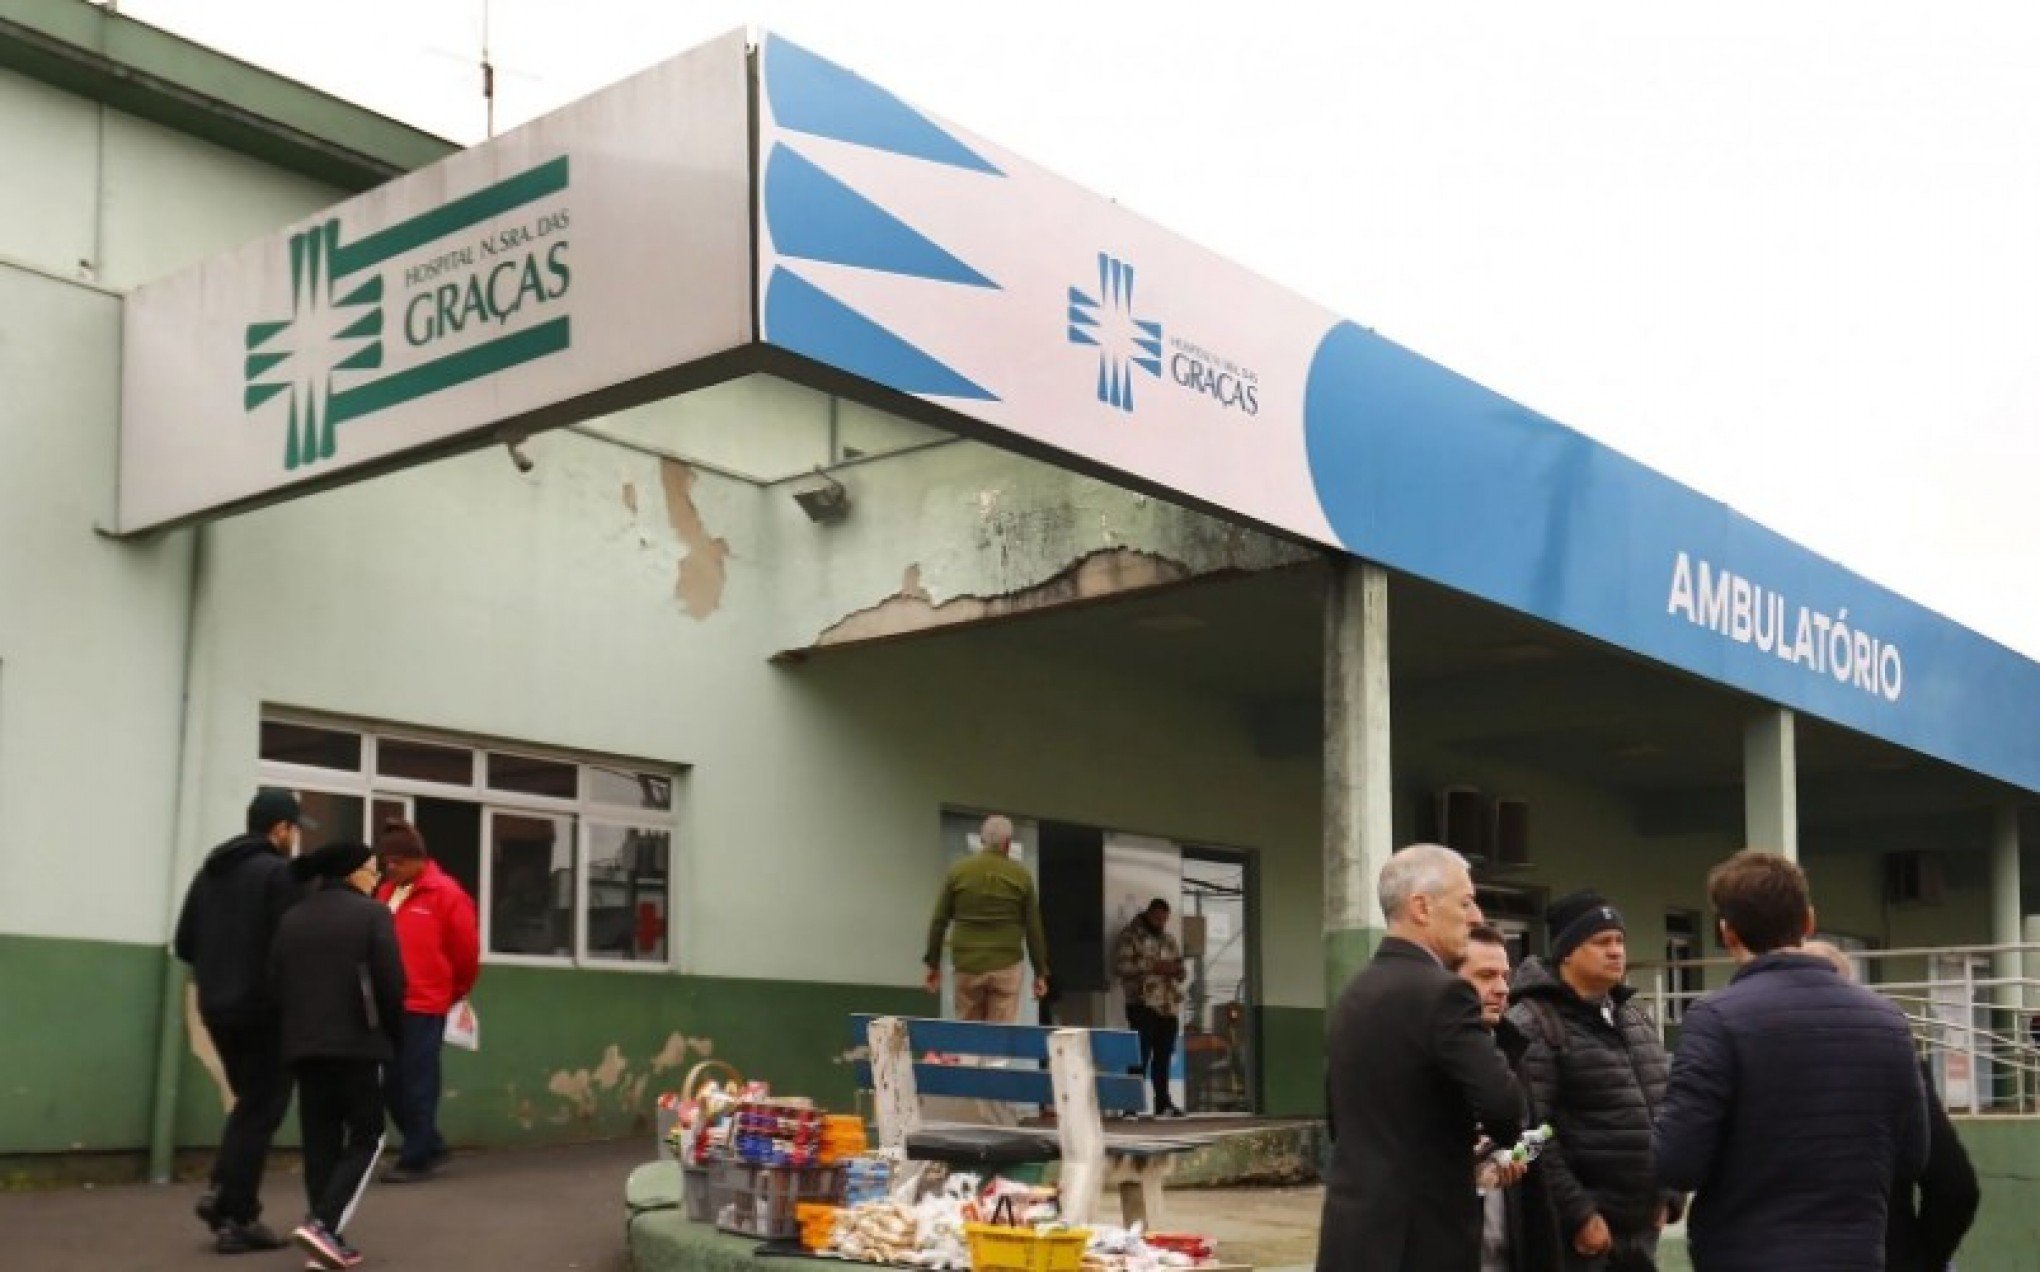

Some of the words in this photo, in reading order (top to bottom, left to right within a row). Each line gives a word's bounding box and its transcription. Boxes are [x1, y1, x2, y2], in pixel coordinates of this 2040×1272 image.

[404, 241, 570, 346] GRAÇAS
[405, 246, 473, 287] HOSPITAL
[537, 208, 570, 237] DAS
[1170, 352, 1258, 416] GRAÇAS
[1667, 550, 1902, 702] AMBULATÓRIO
